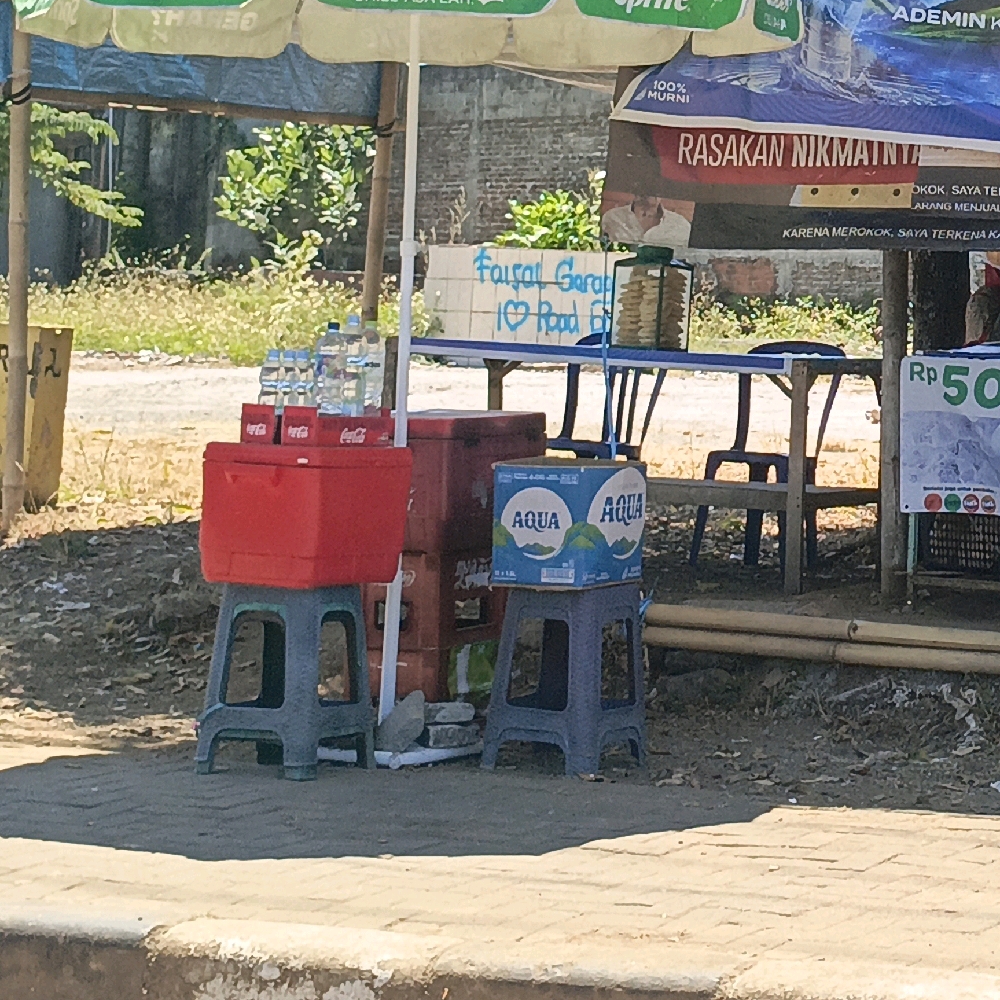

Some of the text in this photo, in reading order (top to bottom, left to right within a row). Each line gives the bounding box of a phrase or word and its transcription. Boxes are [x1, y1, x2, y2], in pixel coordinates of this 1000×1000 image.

[892, 5, 987, 29] ADEMIN
[647, 90, 690, 104] MURNI
[653, 80, 687, 94] 100%
[677, 133, 786, 168] RASAKAN
[951, 185, 982, 196] SAYA
[782, 226, 830, 239] KARENA
[897, 227, 929, 239] SAYA
[931, 228, 987, 240] TERKENA
[909, 361, 937, 386] Rp
[599, 492, 644, 526] AQUA
[511, 510, 561, 532] AQUA
